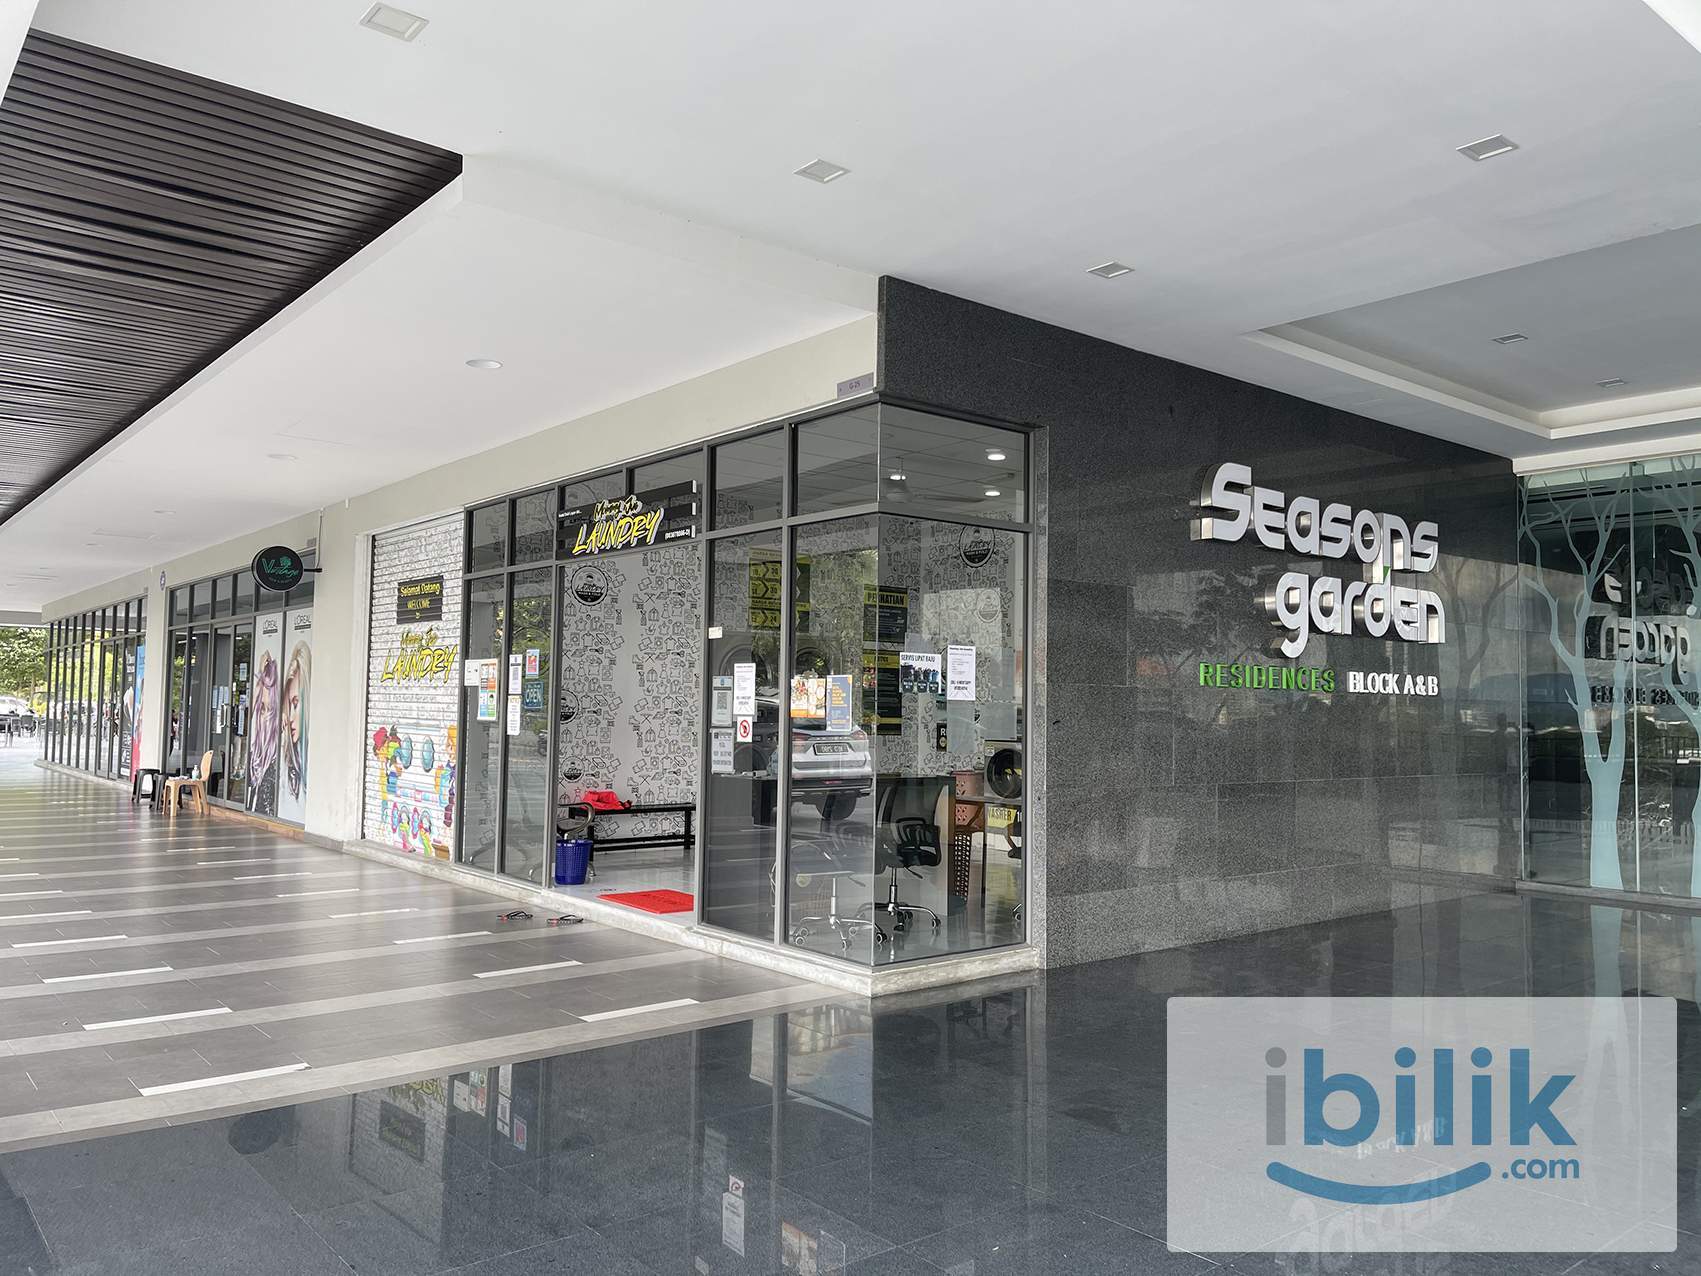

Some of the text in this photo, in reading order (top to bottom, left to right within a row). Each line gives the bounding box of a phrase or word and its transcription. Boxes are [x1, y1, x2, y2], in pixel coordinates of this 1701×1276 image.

[572, 507, 665, 555] LAUNDRY
[1268, 570, 1446, 658] garden
[381, 643, 458, 685] LAUNDRY
[1199, 661, 1439, 697] RESIDENCES BLOCK A&B
